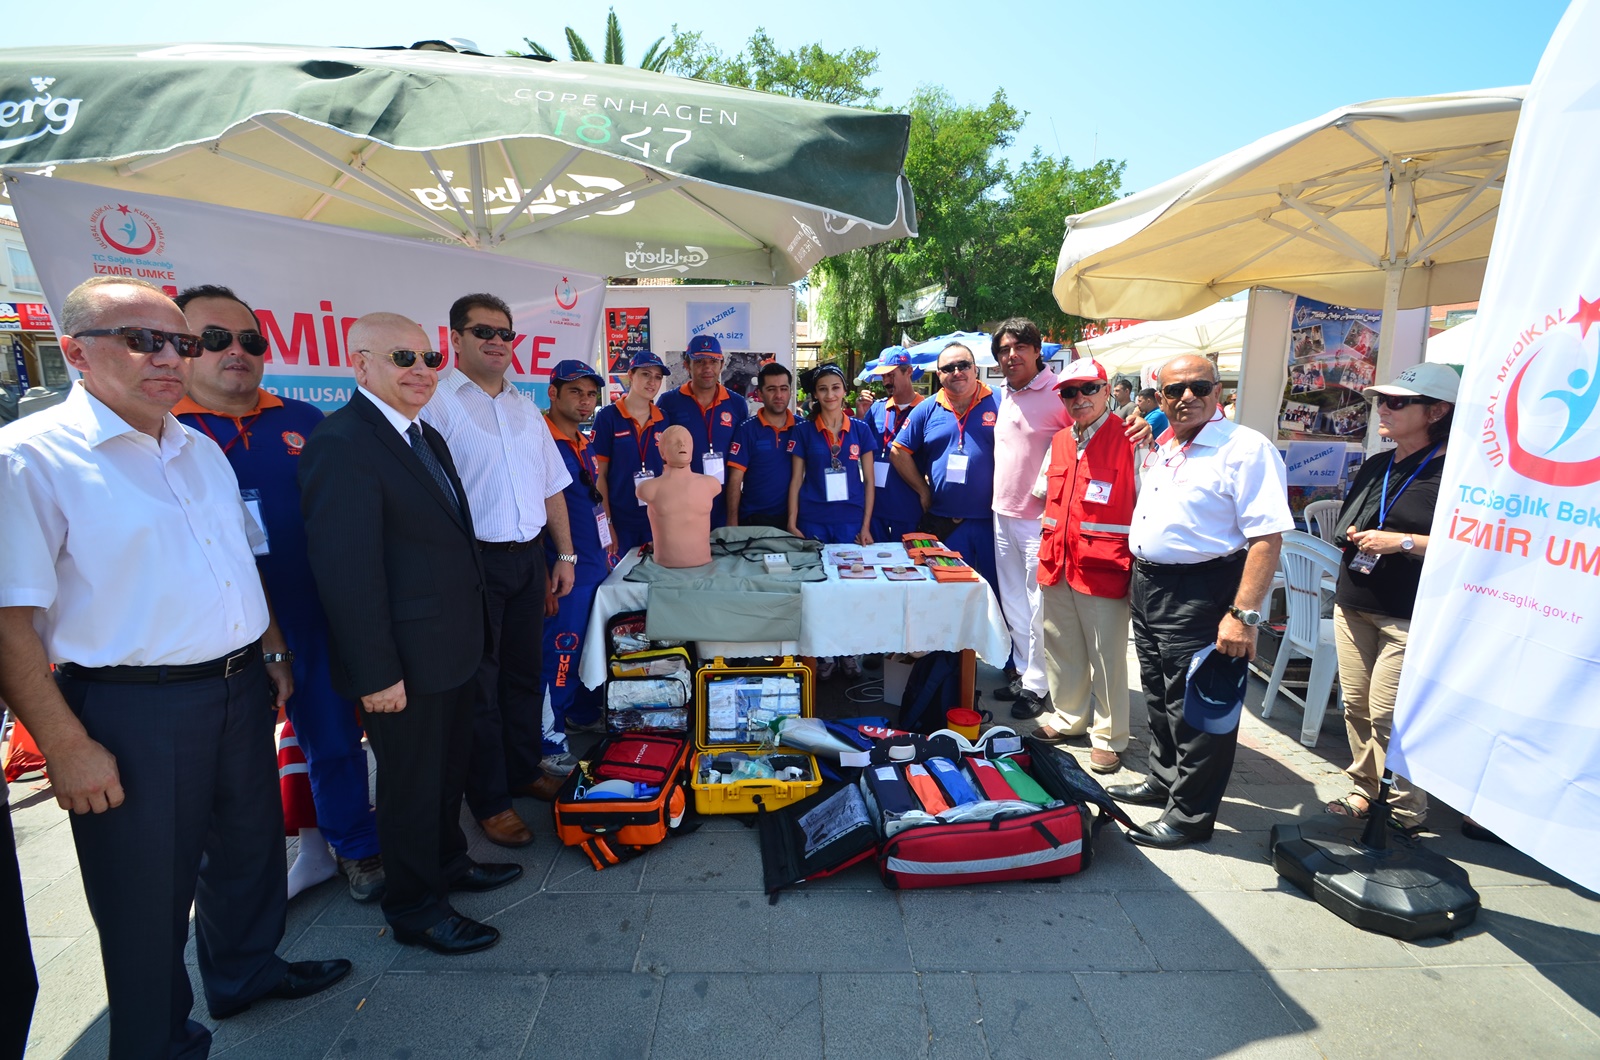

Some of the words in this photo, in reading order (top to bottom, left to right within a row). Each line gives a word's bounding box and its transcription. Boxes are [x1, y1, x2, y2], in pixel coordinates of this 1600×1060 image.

[514, 88, 737, 126] COPENHAGEN
[554, 110, 692, 164] 1847
[90, 224, 108, 250] ULUSAL
[133, 207, 165, 240] KURTARMA
[93, 262, 132, 277] İZMİR
[137, 268, 176, 281] UMKE
[107, 255, 134, 265] Sağlık
[692, 323, 706, 335] BİZ
[705, 306, 736, 327] HAZIRIZ
[726, 331, 744, 340] SİZ?
[1482, 390, 1504, 468] ULUSAL
[1497, 307, 1567, 383] MEDİKAL
[1288, 462, 1302, 472] BİZ
[1303, 446, 1335, 466] HAZIRIZ
[1448, 508, 1532, 558] İZMİR
[1463, 582, 1583, 625] www.saglik.gov.tr
[555, 654, 571, 687] UMKE
